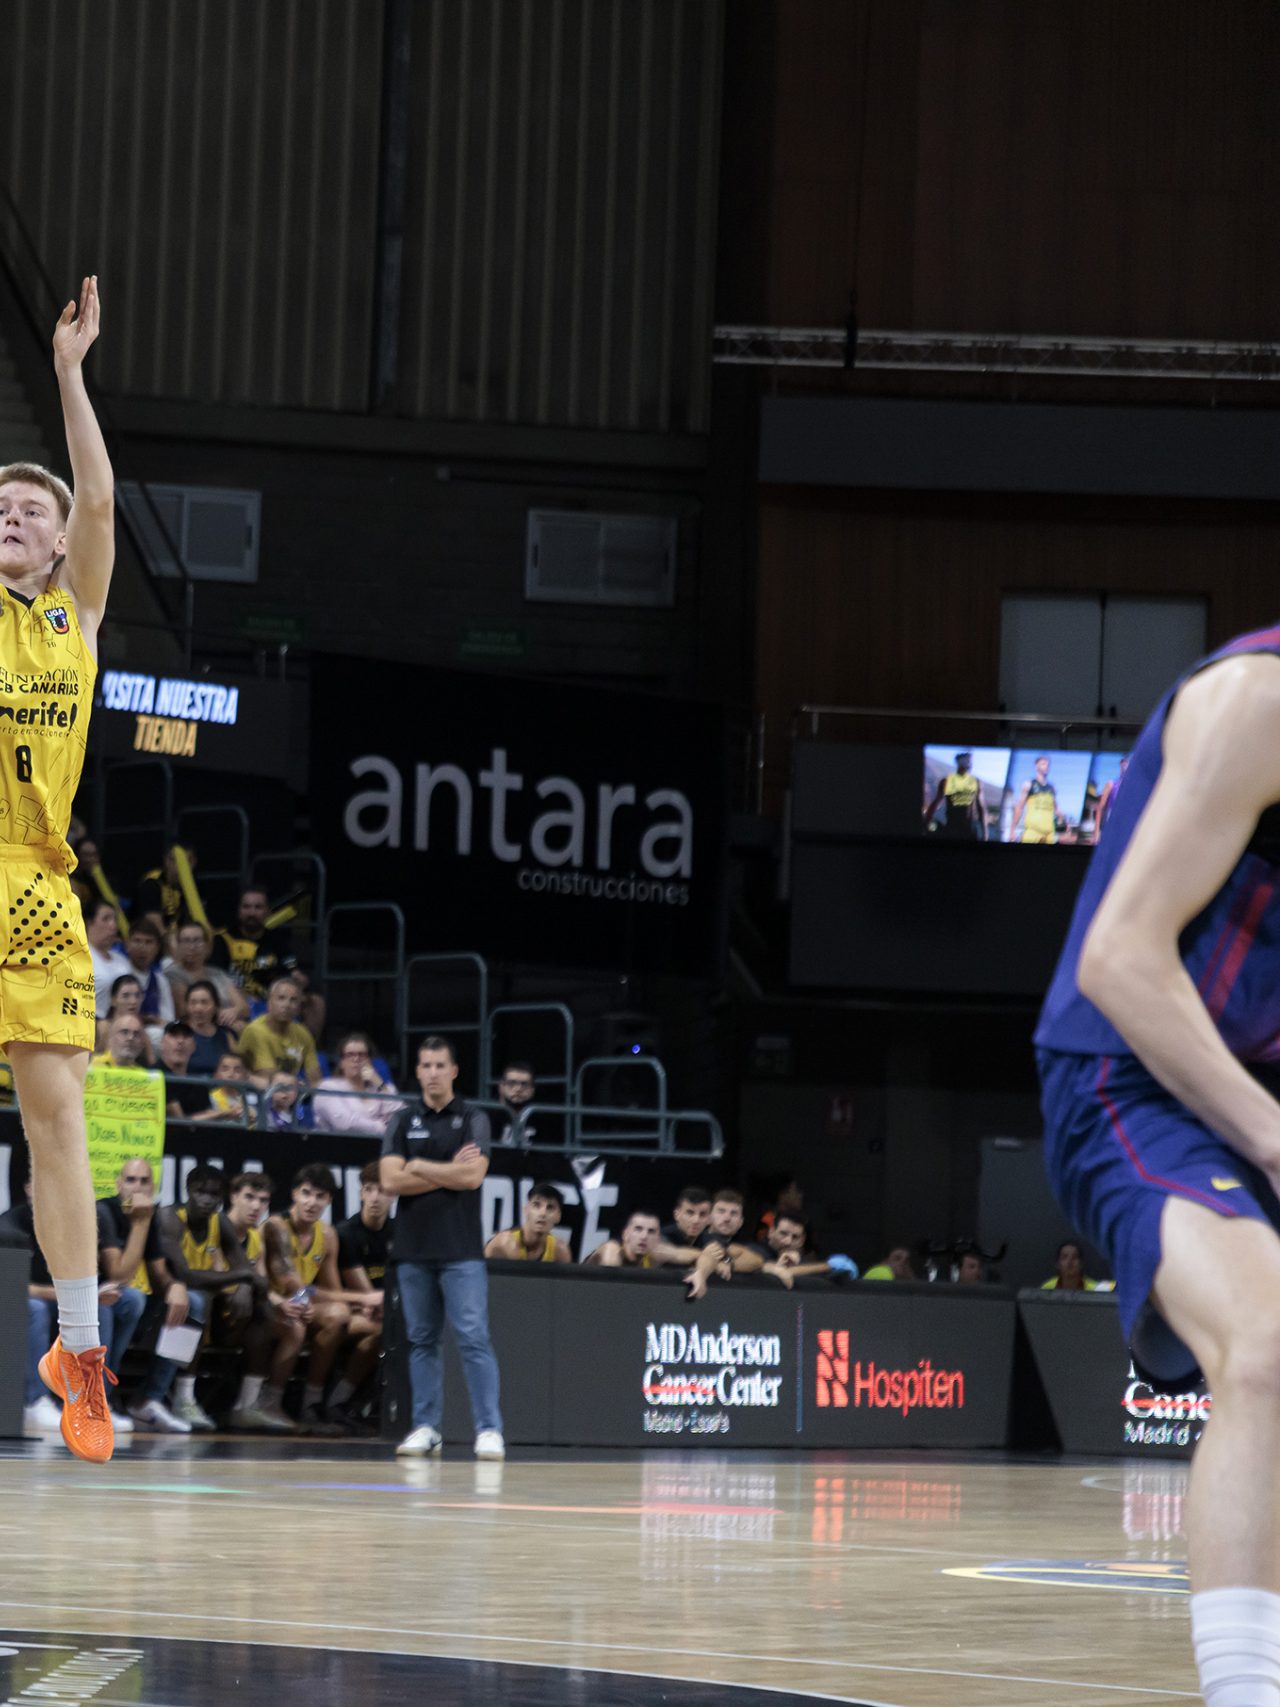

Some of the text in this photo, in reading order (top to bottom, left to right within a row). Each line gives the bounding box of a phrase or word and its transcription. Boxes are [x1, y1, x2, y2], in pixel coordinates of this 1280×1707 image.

[18, 681, 79, 696] CANARIAS
[154, 677, 239, 725] NUESTRA
[133, 714, 198, 757] TIENDA
[343, 747, 694, 879] antara
[517, 870, 690, 906] construcciones
[644, 1321, 781, 1366] MD Anderson
[642, 1364, 782, 1407] Cancer Center
[853, 1358, 964, 1418] Hospiten
[1122, 1420, 1191, 1446] Madrid
